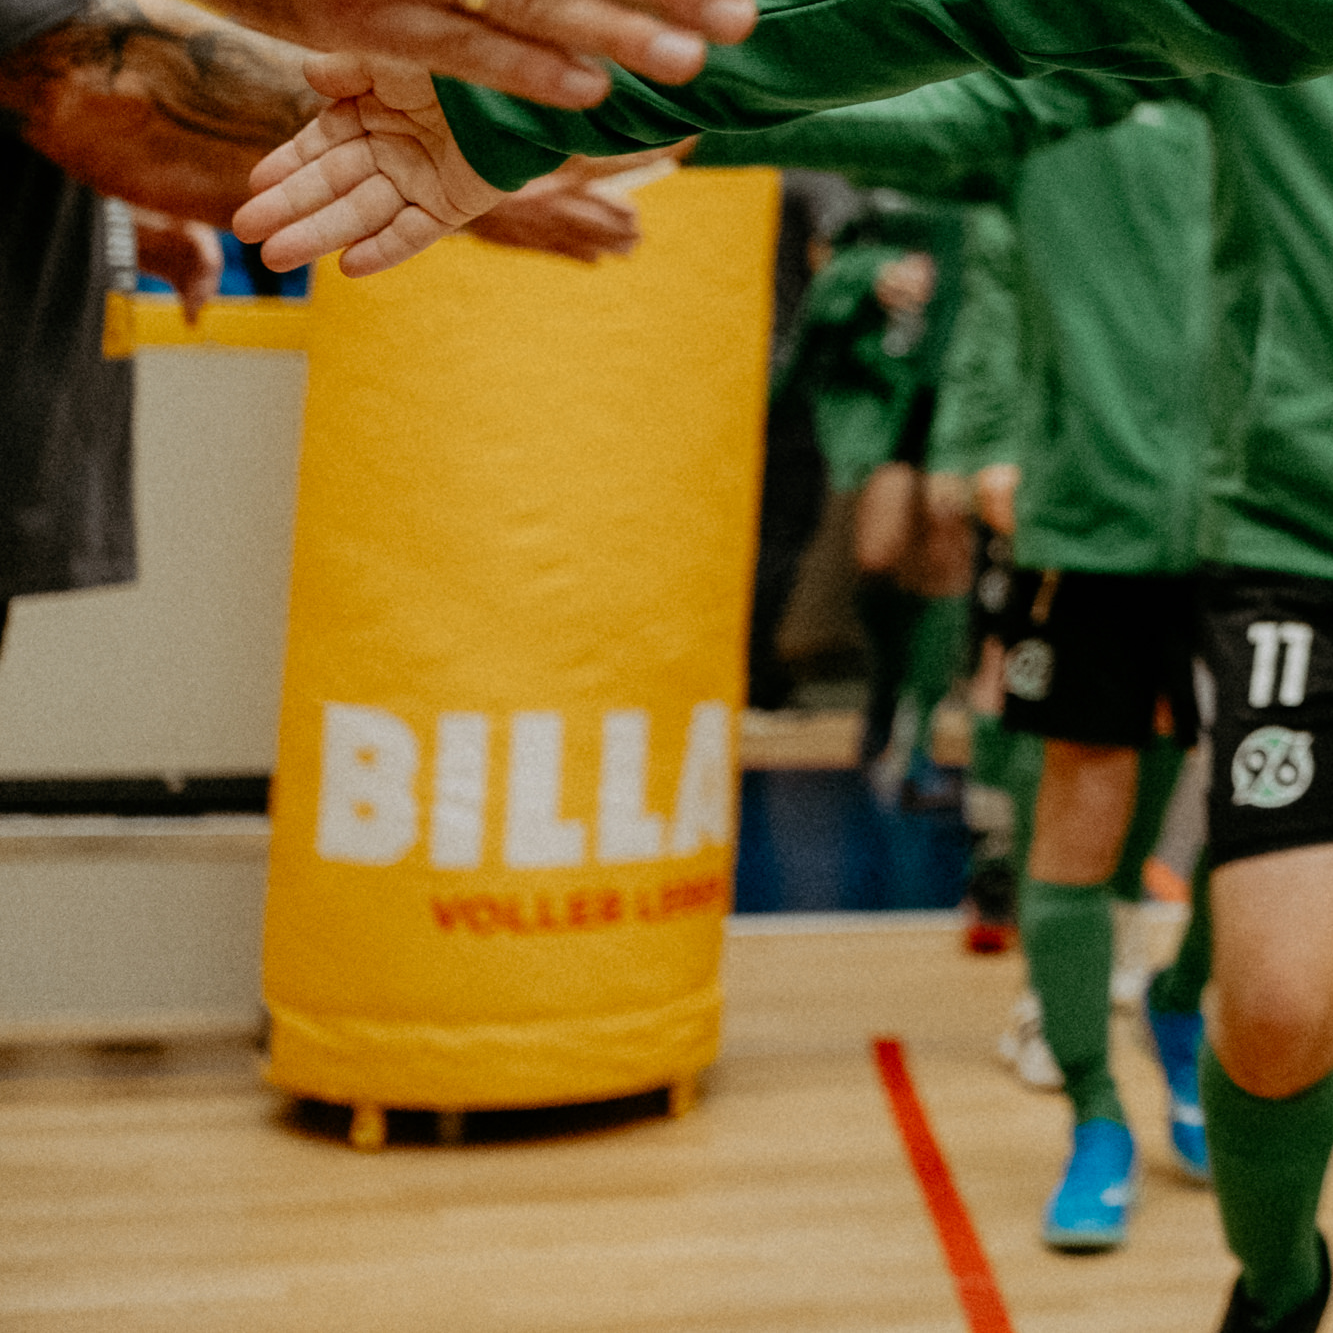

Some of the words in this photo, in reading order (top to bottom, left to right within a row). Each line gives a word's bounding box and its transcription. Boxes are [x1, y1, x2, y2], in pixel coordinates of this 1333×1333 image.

[1246, 621, 1314, 708] 11
[316, 700, 731, 869] BILLA
[1231, 726, 1315, 809] 96
